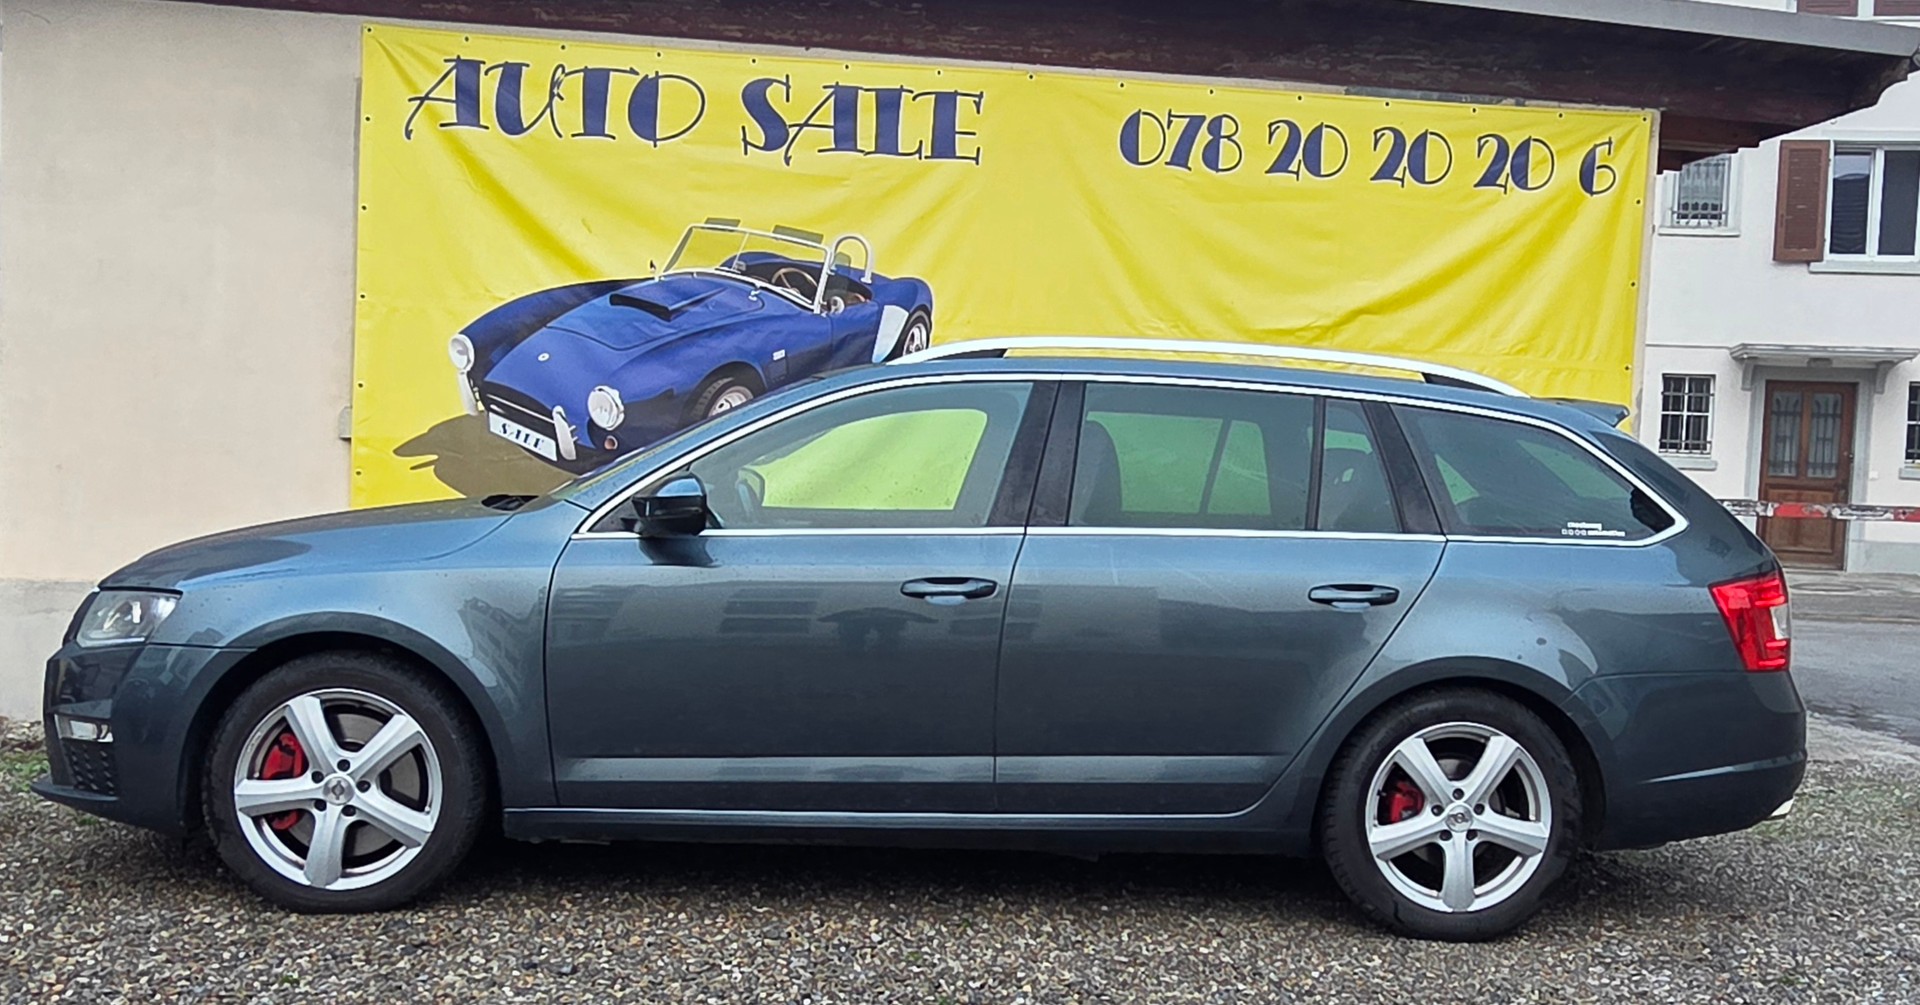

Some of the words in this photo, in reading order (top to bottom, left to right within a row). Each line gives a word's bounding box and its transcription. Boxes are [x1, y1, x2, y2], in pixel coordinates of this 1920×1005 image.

[405, 55, 706, 147] AUTO
[741, 74, 984, 165] SALE
[1119, 109, 1242, 172] 078
[1264, 119, 1348, 181] 20
[1369, 126, 1453, 188] 20
[1473, 132, 1556, 194] 20
[1578, 136, 1617, 196] 6
[499, 423, 545, 450] SALE
